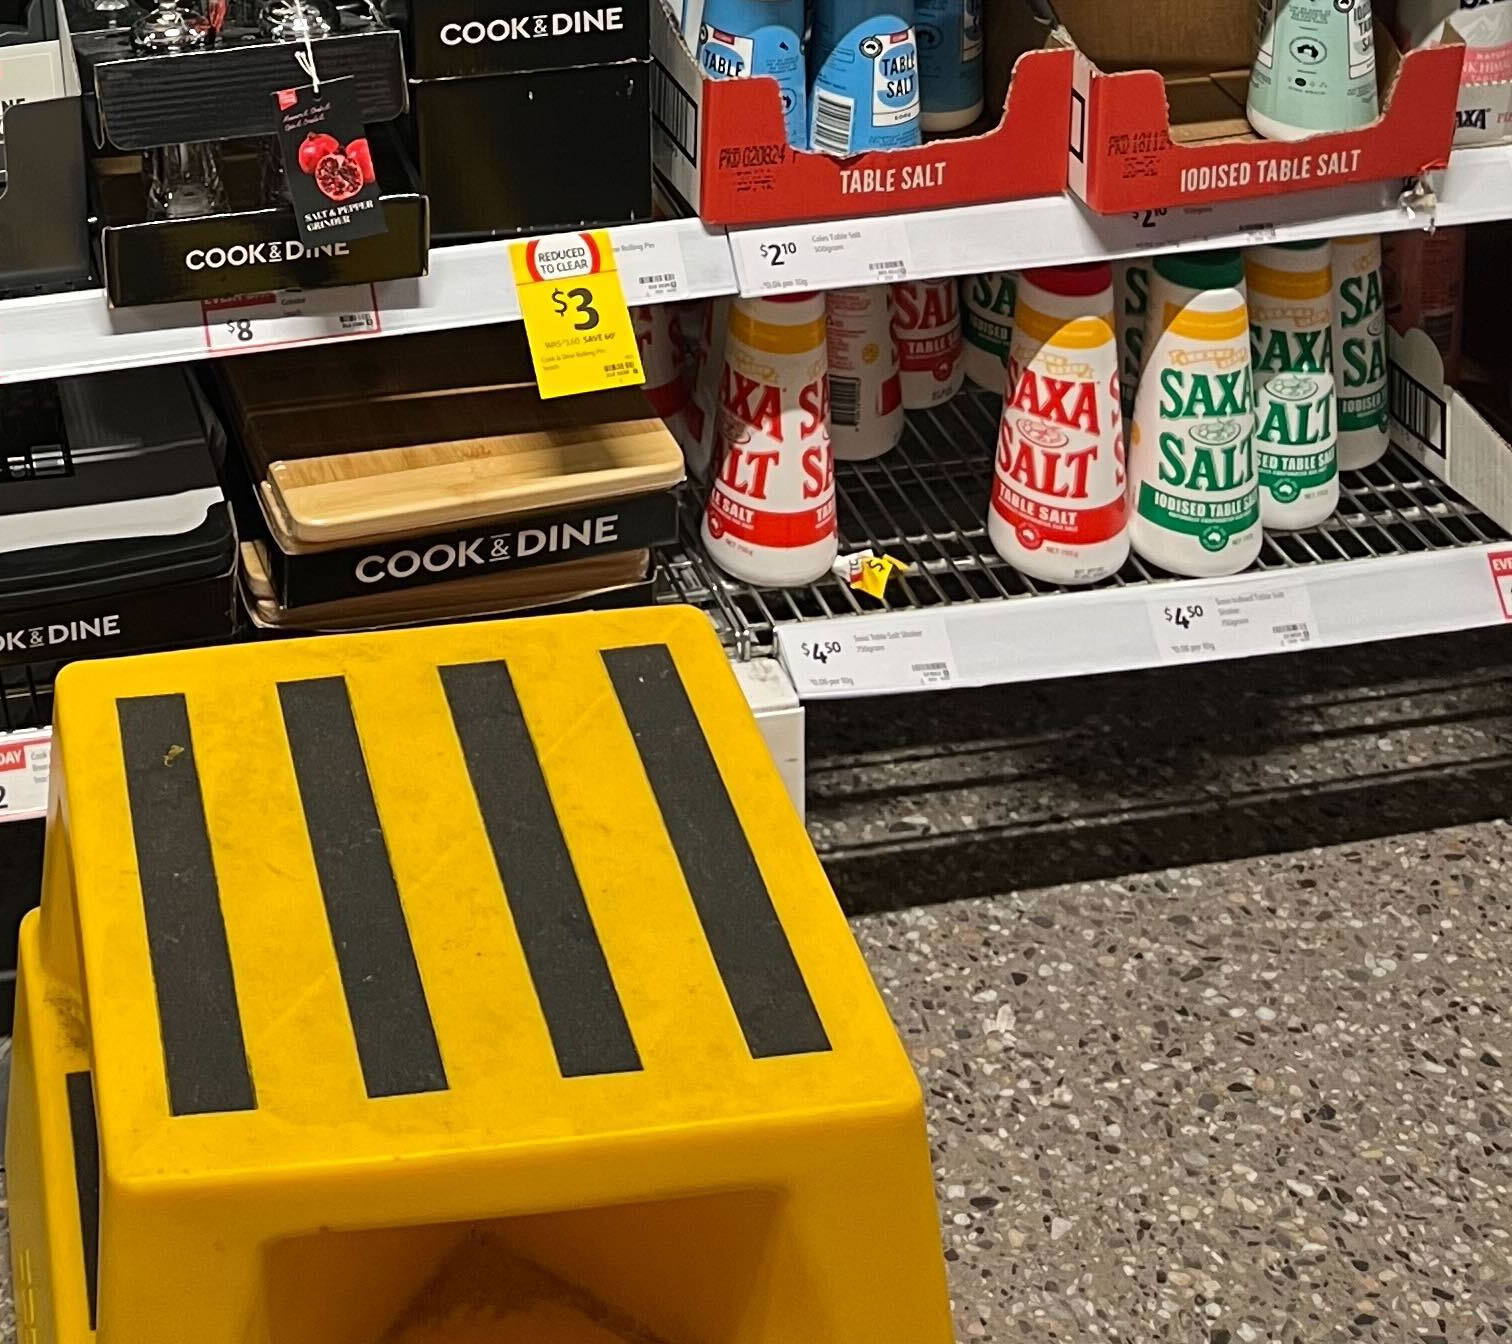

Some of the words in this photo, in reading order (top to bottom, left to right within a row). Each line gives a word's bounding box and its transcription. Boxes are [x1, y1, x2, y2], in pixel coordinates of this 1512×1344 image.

[881, 54, 916, 73] TABLE
[839, 167, 898, 195] TABLE
[901, 162, 947, 191] SALT
[1180, 158, 1250, 193] IODISED
[1256, 154, 1313, 184] TABLE
[1316, 150, 1361, 178] SALT
[538, 246, 586, 265] REDUCED
[540, 262, 554, 274] TO
[556, 257, 588, 274] CLEAR
[552, 287, 600, 331] $3
[226, 318, 253, 341] $8
[1007, 359, 1103, 436] SAXA
[998, 415, 1097, 500] SALT
[1159, 432, 1255, 493] SALT
[1154, 492, 1206, 517] IODISED
[1208, 497, 1243, 517] TABLE
